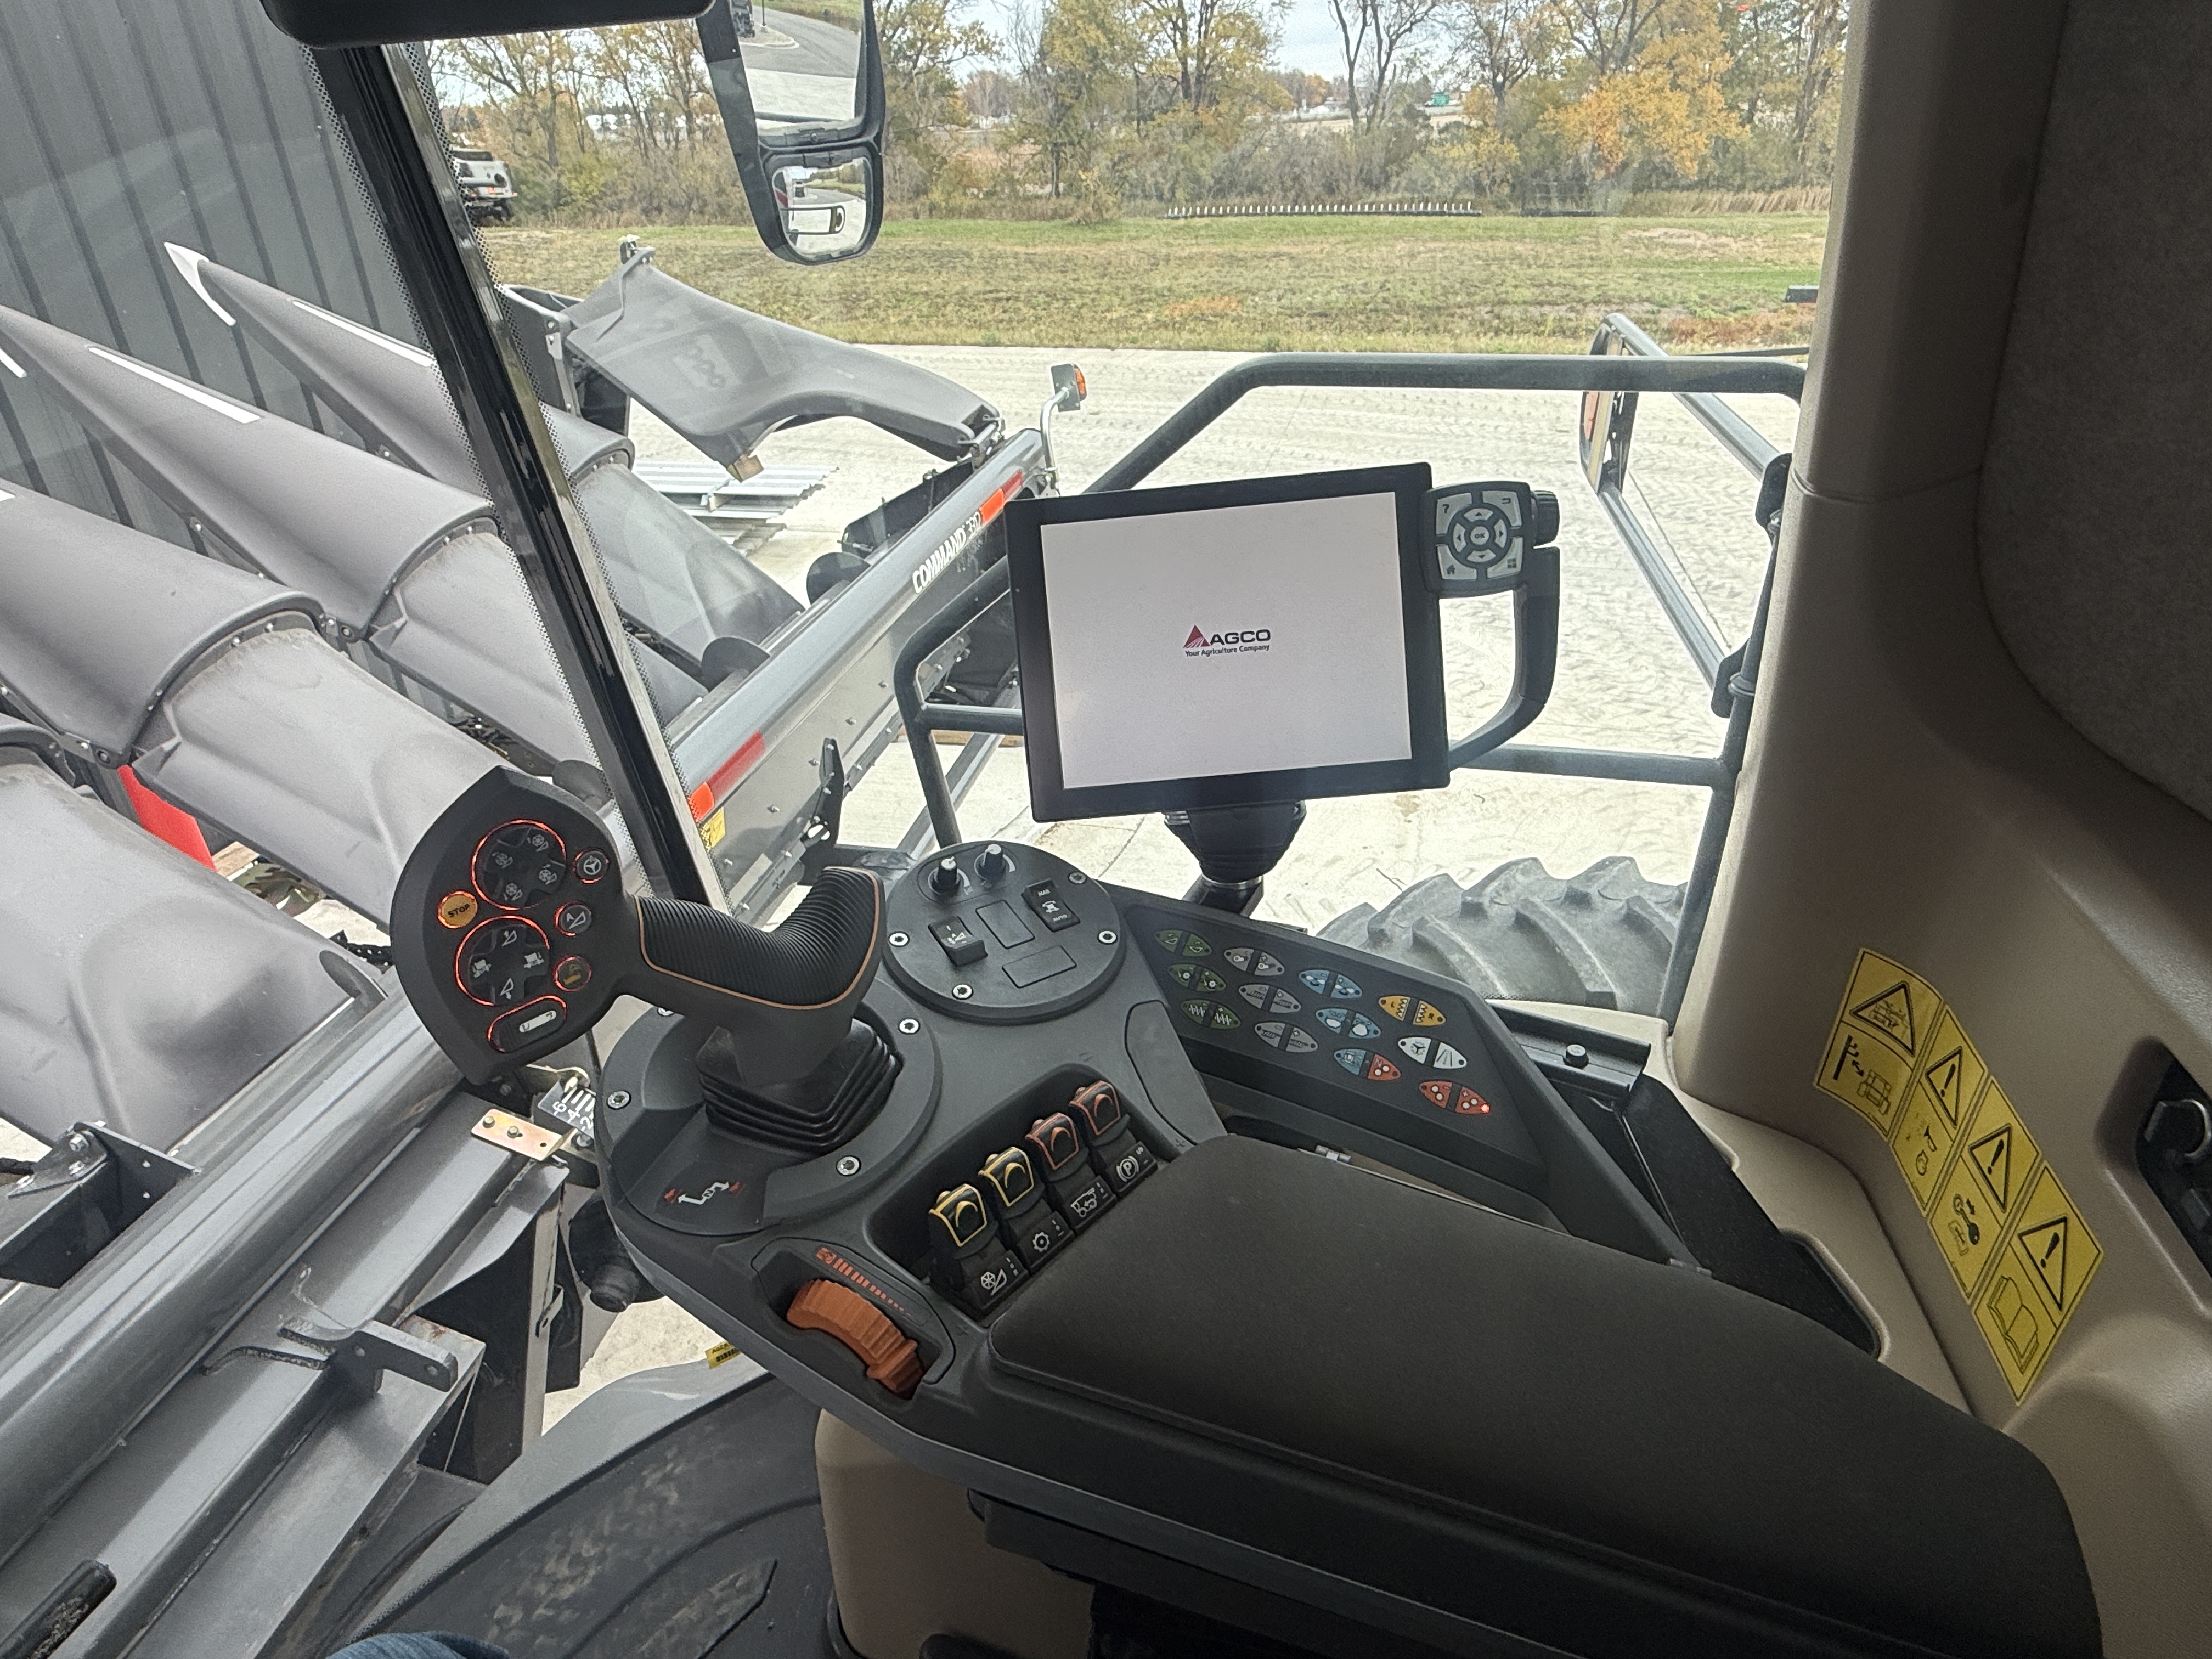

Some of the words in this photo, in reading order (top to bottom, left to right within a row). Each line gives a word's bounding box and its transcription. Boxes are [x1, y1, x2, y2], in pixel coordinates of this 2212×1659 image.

[912, 528, 966, 594] COMMAND
[1210, 629, 1271, 645] AGCO
[1201, 647, 1238, 657] Agriculture
[1239, 645, 1270, 653] Company
[448, 903, 470, 917] STOP
